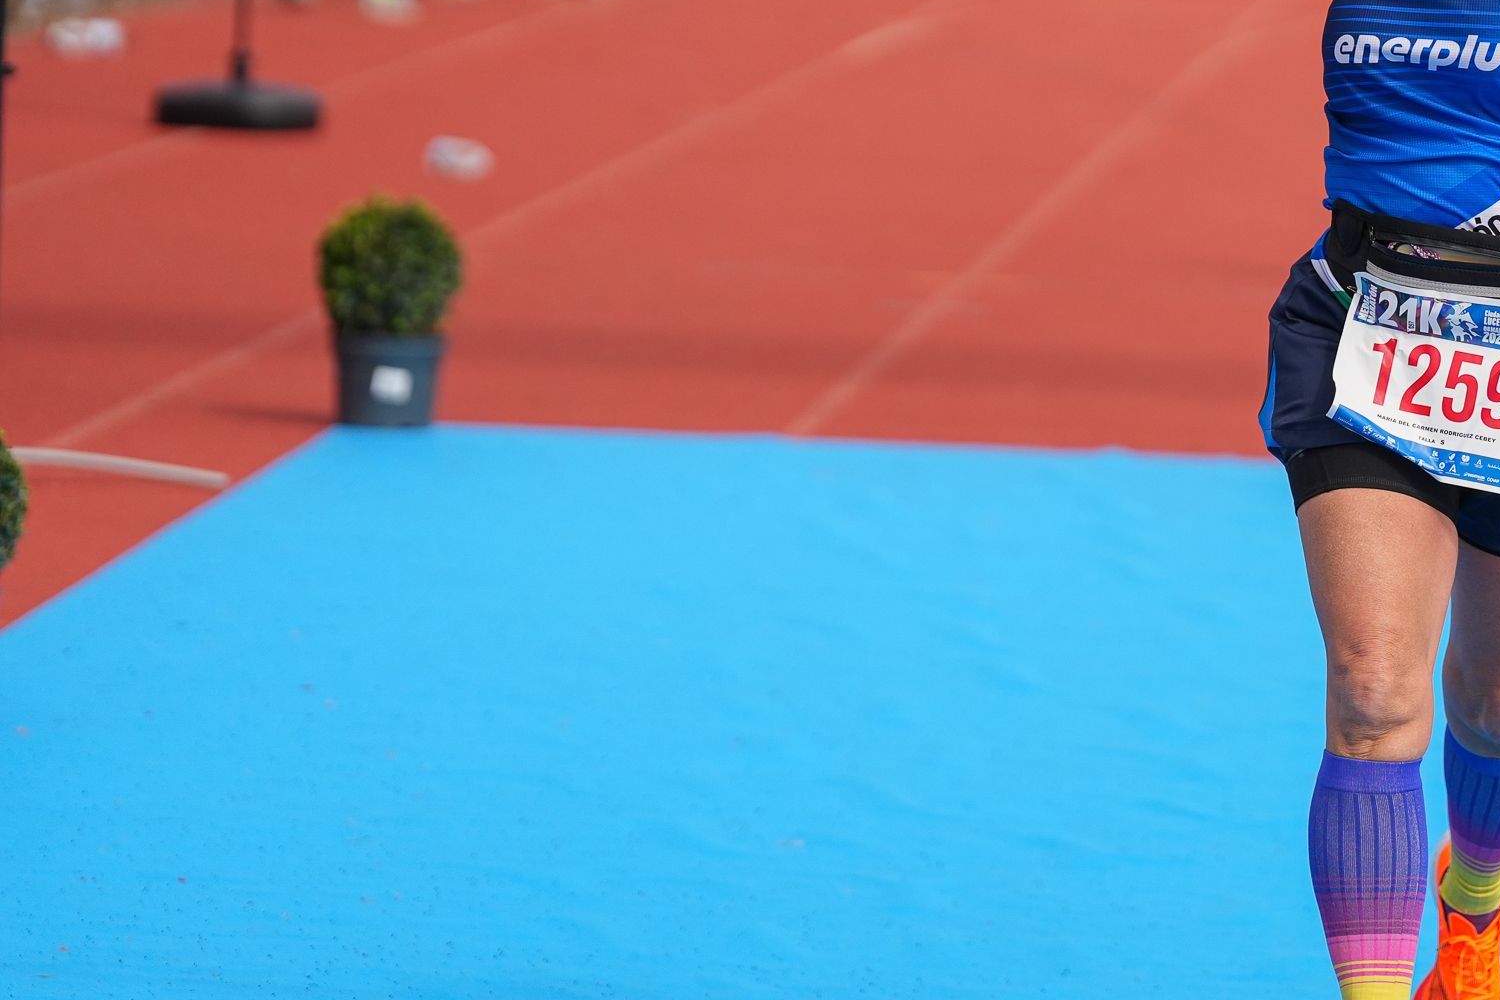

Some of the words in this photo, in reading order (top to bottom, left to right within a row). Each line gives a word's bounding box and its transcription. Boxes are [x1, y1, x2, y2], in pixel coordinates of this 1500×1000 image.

[1378, 290, 1443, 336] 21K
[1377, 414, 1397, 423] MARIA
[1412, 423, 1438, 433] CARMEN
